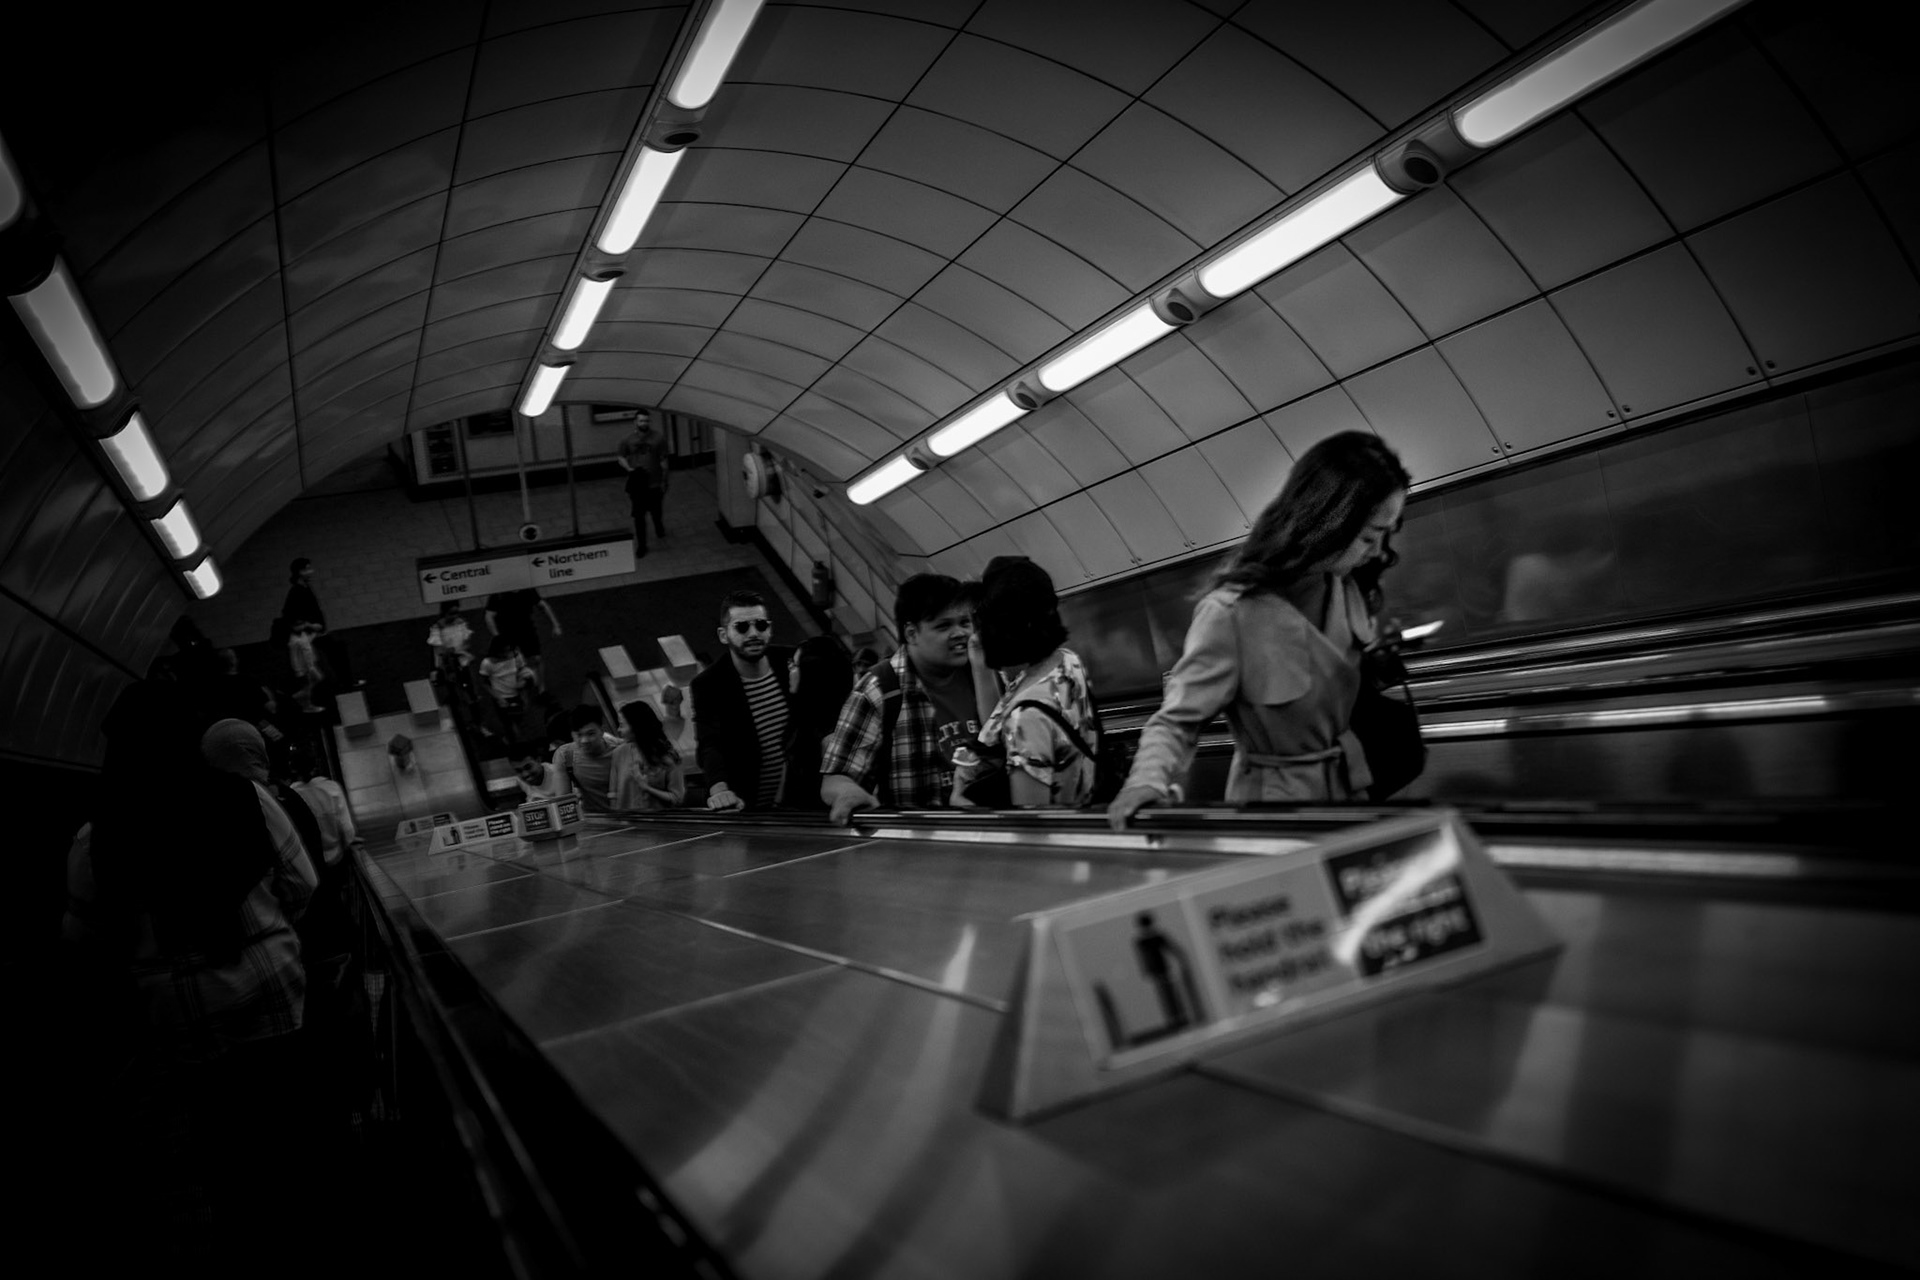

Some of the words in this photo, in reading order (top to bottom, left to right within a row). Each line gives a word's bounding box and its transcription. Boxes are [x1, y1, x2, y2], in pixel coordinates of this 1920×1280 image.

[548, 549, 608, 566] Northern
[440, 565, 491, 582] Central
[549, 567, 573, 579] line
[442, 584, 467, 596] line
[559, 803, 575, 815] STOP
[525, 811, 545, 822] STOP
[1208, 895, 1291, 929] Please
